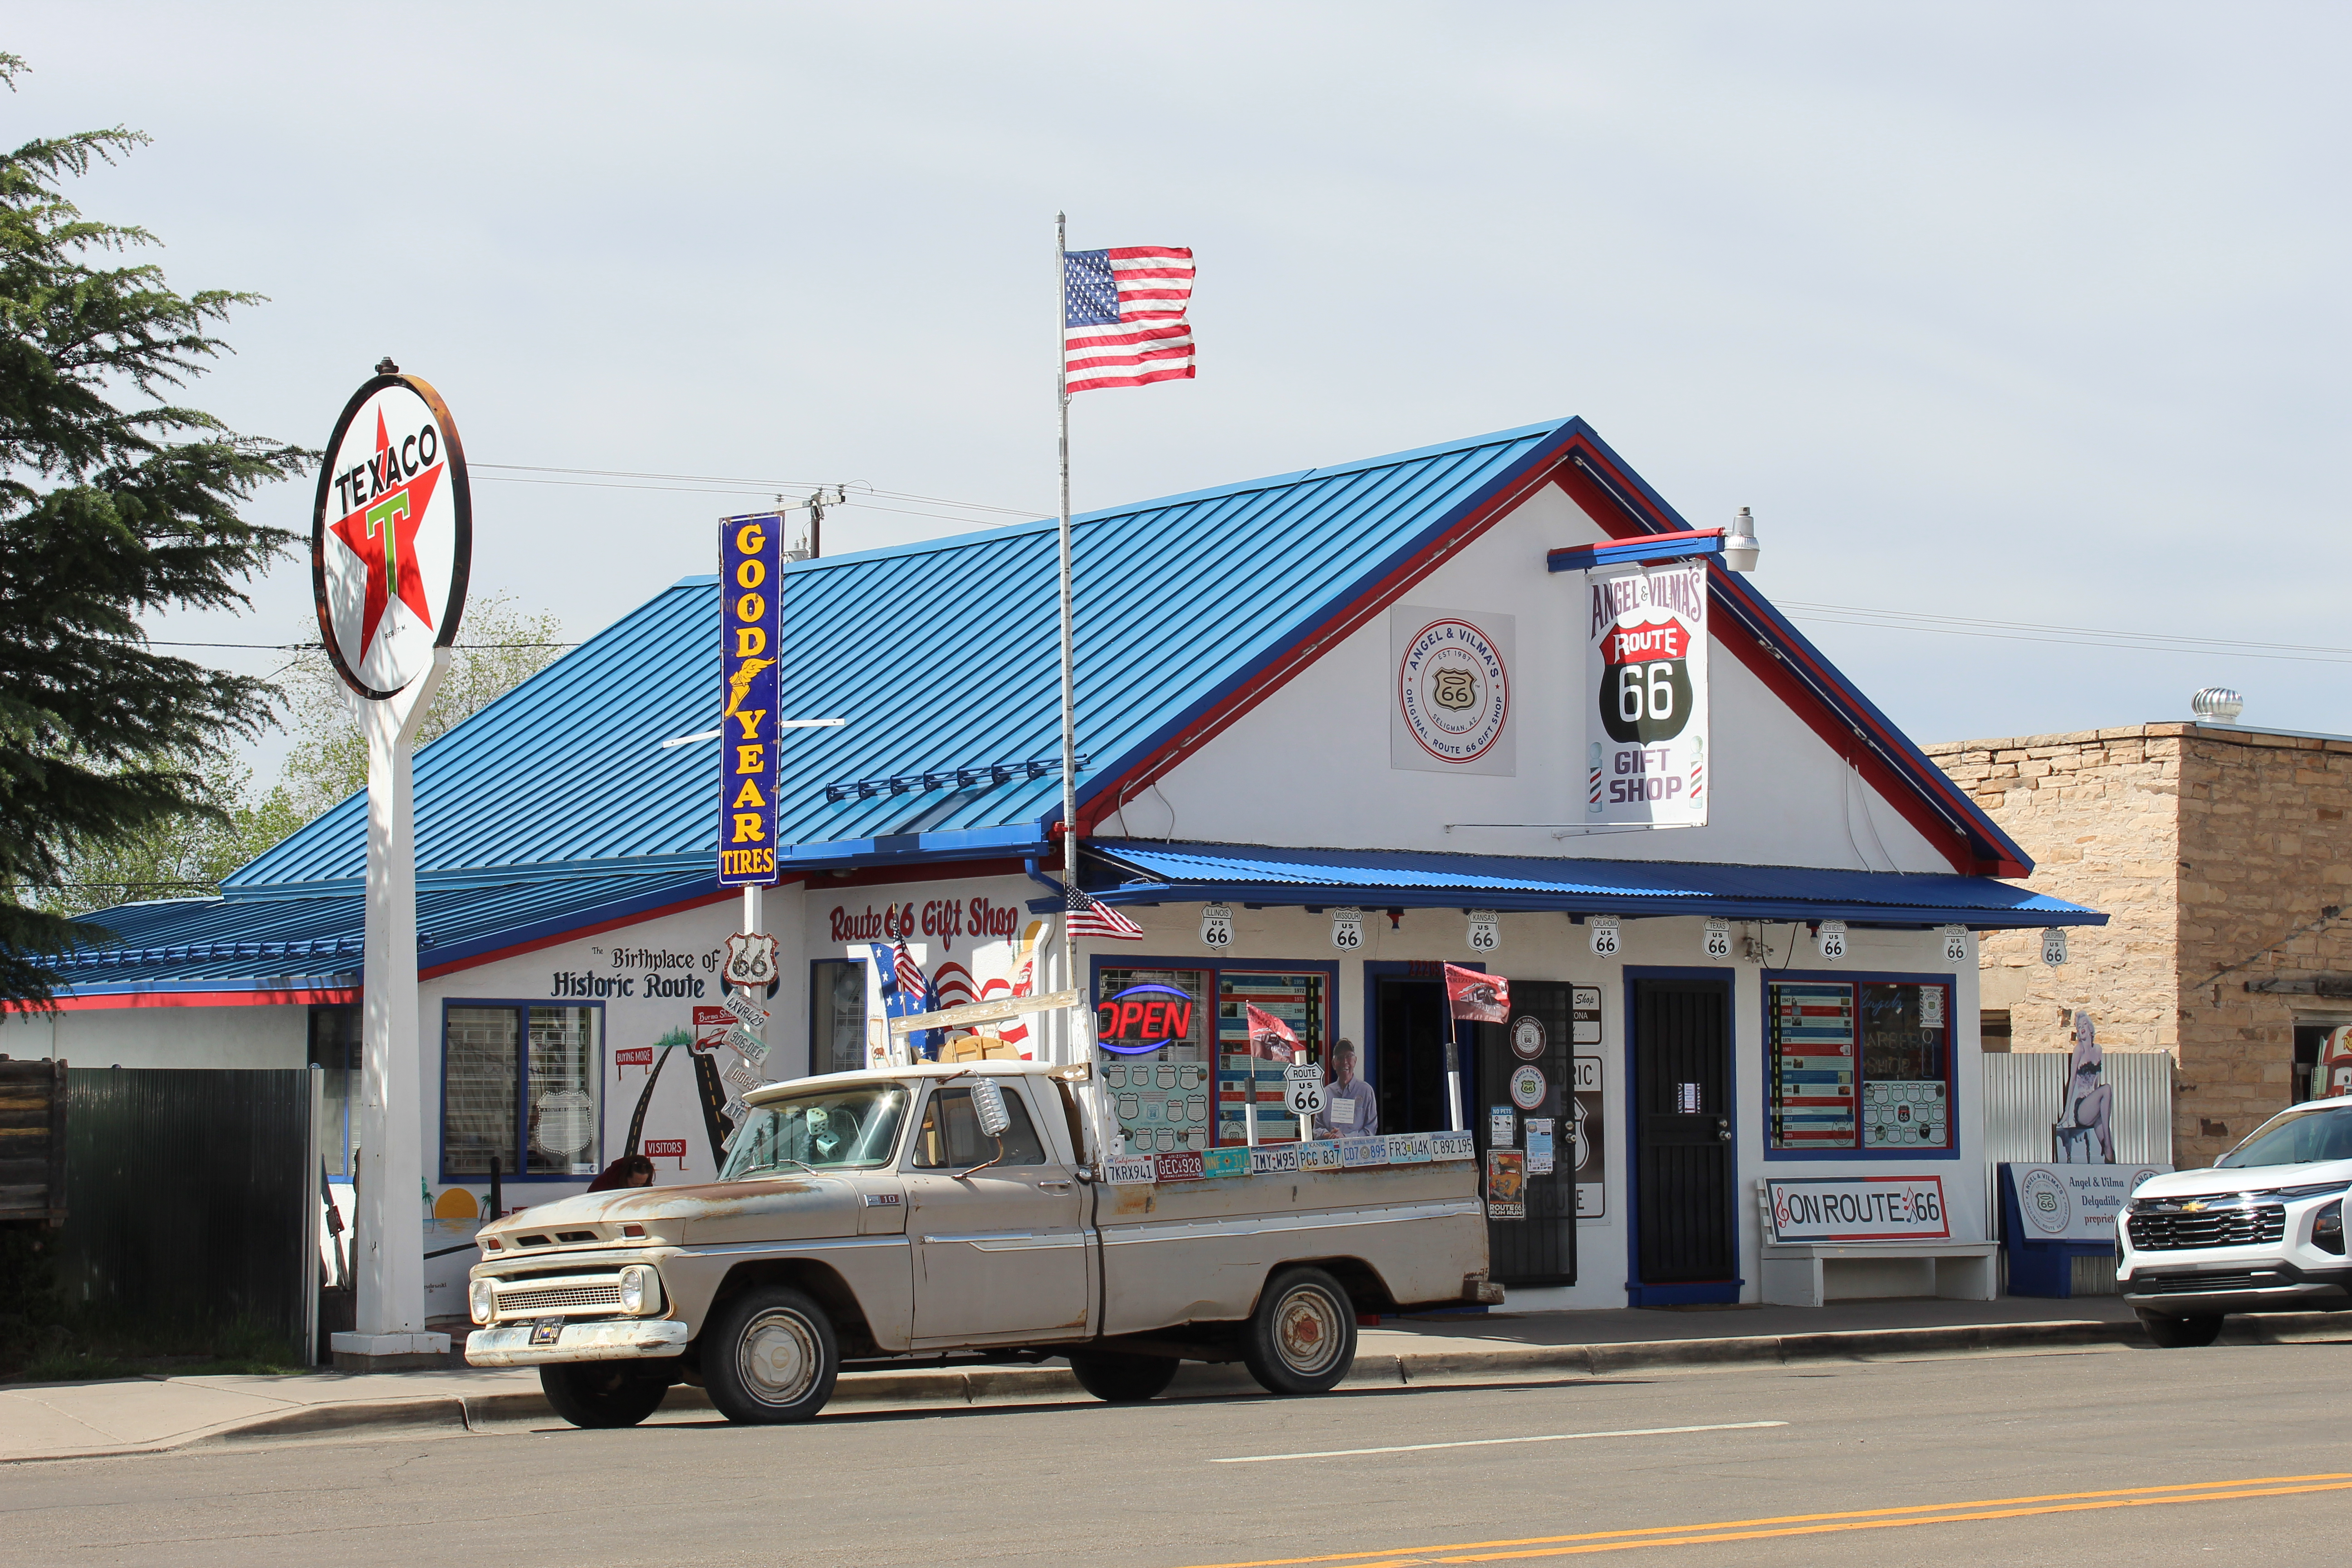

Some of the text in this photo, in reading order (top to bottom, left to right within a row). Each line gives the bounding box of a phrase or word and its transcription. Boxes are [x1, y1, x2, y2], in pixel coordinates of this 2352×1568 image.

[335, 425, 436, 514] TEXACO
[366, 491, 411, 598] T
[1590, 566, 1702, 642] ANGEL & VILMA'S
[385, 630, 396, 640] REG.
[1409, 627, 1499, 678] ANGEL & VILMA'S
[1613, 627, 1678, 664] ROUTE
[1438, 650, 1471, 662] EST 1987
[1441, 686, 1468, 702] 66
[1618, 662, 1673, 722] 66
[1406, 689, 1502, 754] ORIGINAL ROUTE 66 GIFT SHOP
[1432, 713, 1478, 732] SELIGMAN, AZ
[1614, 748, 1671, 775] GIFT
[1609, 776, 1683, 804] SHOP
[721, 848, 774, 875] TIRES
[1206, 909, 1229, 917] ILLINOIS
[1335, 912, 1360, 920] MISSOURI
[1473, 914, 1495, 922] KANSAS
[829, 897, 1019, 952] Route 66 Gift Shop
[1206, 927, 1227, 943] 66
[1337, 931, 1357, 946] 66
[1473, 932, 1493, 947] 66
[1596, 937, 1615, 952] 66
[1709, 939, 1726, 954] 66
[1825, 941, 1842, 955] 66
[1947, 945, 1964, 959] 66
[592, 946, 721, 973] The Birthplace of
[732, 947, 767, 977] 66
[2046, 949, 2062, 962] 66
[551, 970, 705, 998] Historic Route
[1575, 994, 1594, 1006] Shop
[698, 1011, 719, 1022] Burma
[726, 996, 764, 1026] 4XVR429
[1098, 1002, 1192, 1039] OPEN
[1522, 1019, 1540, 1027] SUPPORT
[617, 1049, 651, 1063] BUYING MORE
[1294, 1069, 1316, 1078] ROUTE
[1514, 1070, 1525, 1082] ANGEL
[1295, 1091, 1319, 1110] 66
[648, 1142, 682, 1154] VISITORS
[1344, 1145, 1386, 1160] CD7 895
[1389, 1142, 1407, 1156] FR3
[1433, 1138, 1472, 1154] C 892 195
[1115, 1157, 1142, 1165] California
[1205, 1156, 1220, 1170] NNF
[1301, 1150, 1339, 1166] PCG 837
[1109, 1165, 1153, 1180] 7KRX941
[2025, 1176, 2036, 1194] ANGEL
[2042, 1173, 2063, 1194] VILMA'S
[2069, 1177, 2124, 1190] Angel & Vilma
[1788, 1193, 1940, 1224] ON ROUTE 66
[2082, 1196, 2120, 1208] Delgadillo
[2027, 1202, 2040, 1225] ORIGINAL
[534, 1323, 560, 1339] RT 66
